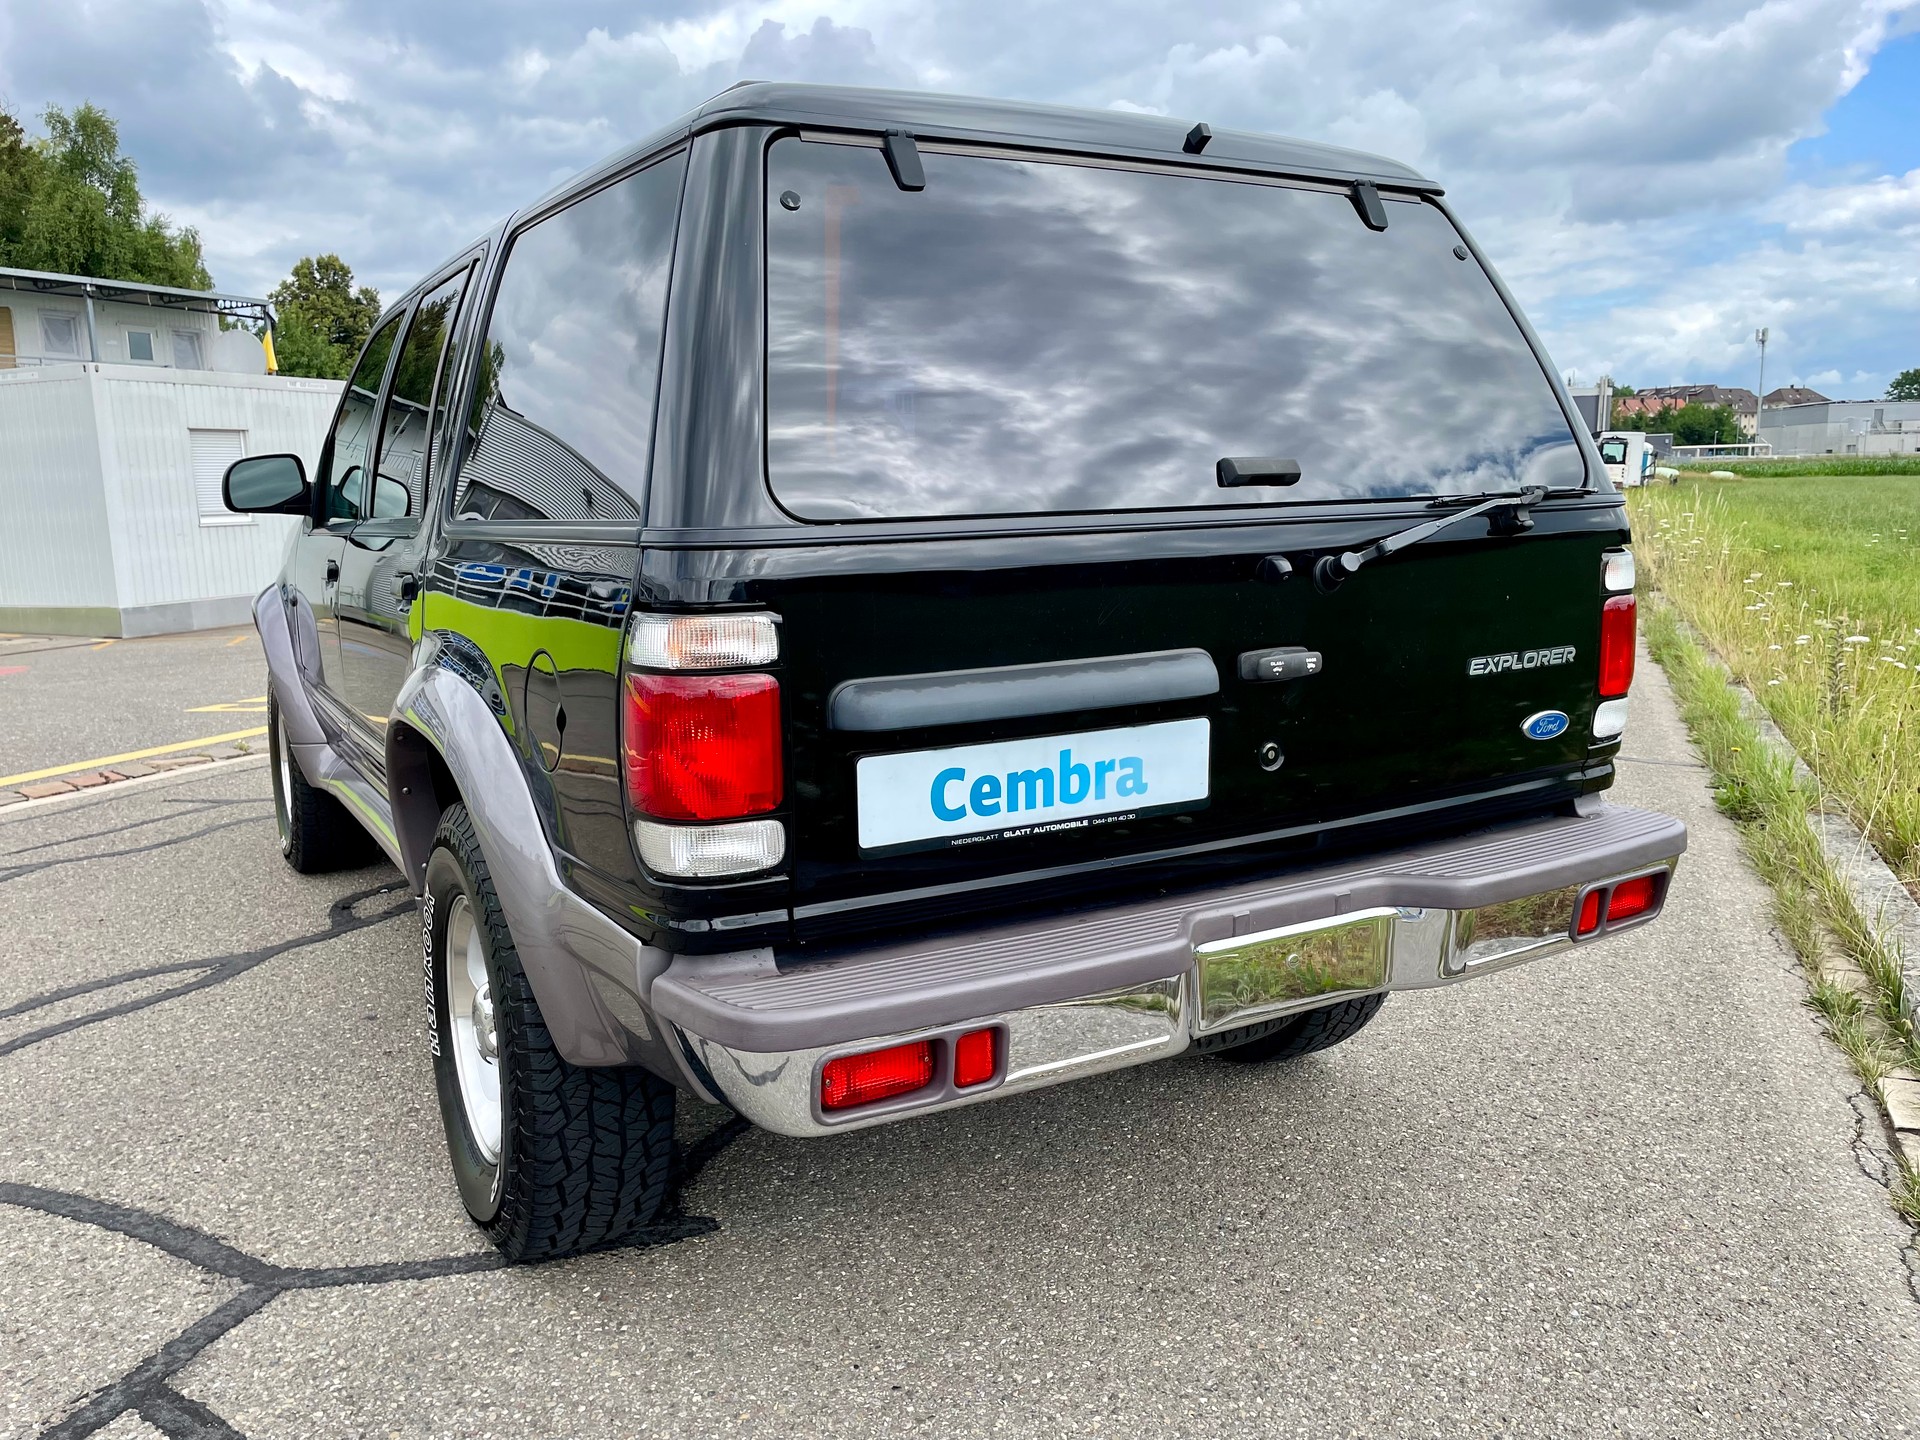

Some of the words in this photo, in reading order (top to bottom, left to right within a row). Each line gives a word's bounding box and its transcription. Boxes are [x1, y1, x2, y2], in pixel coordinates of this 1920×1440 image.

[1469, 646, 1576, 676] EXPLORER
[1536, 717, 1561, 734] Ford
[930, 748, 1148, 822] Cembra
[951, 834, 999, 846] NIEDERGLATT
[1003, 828, 1031, 838] GLATT
[1033, 819, 1089, 834] AUTOMOBILE
